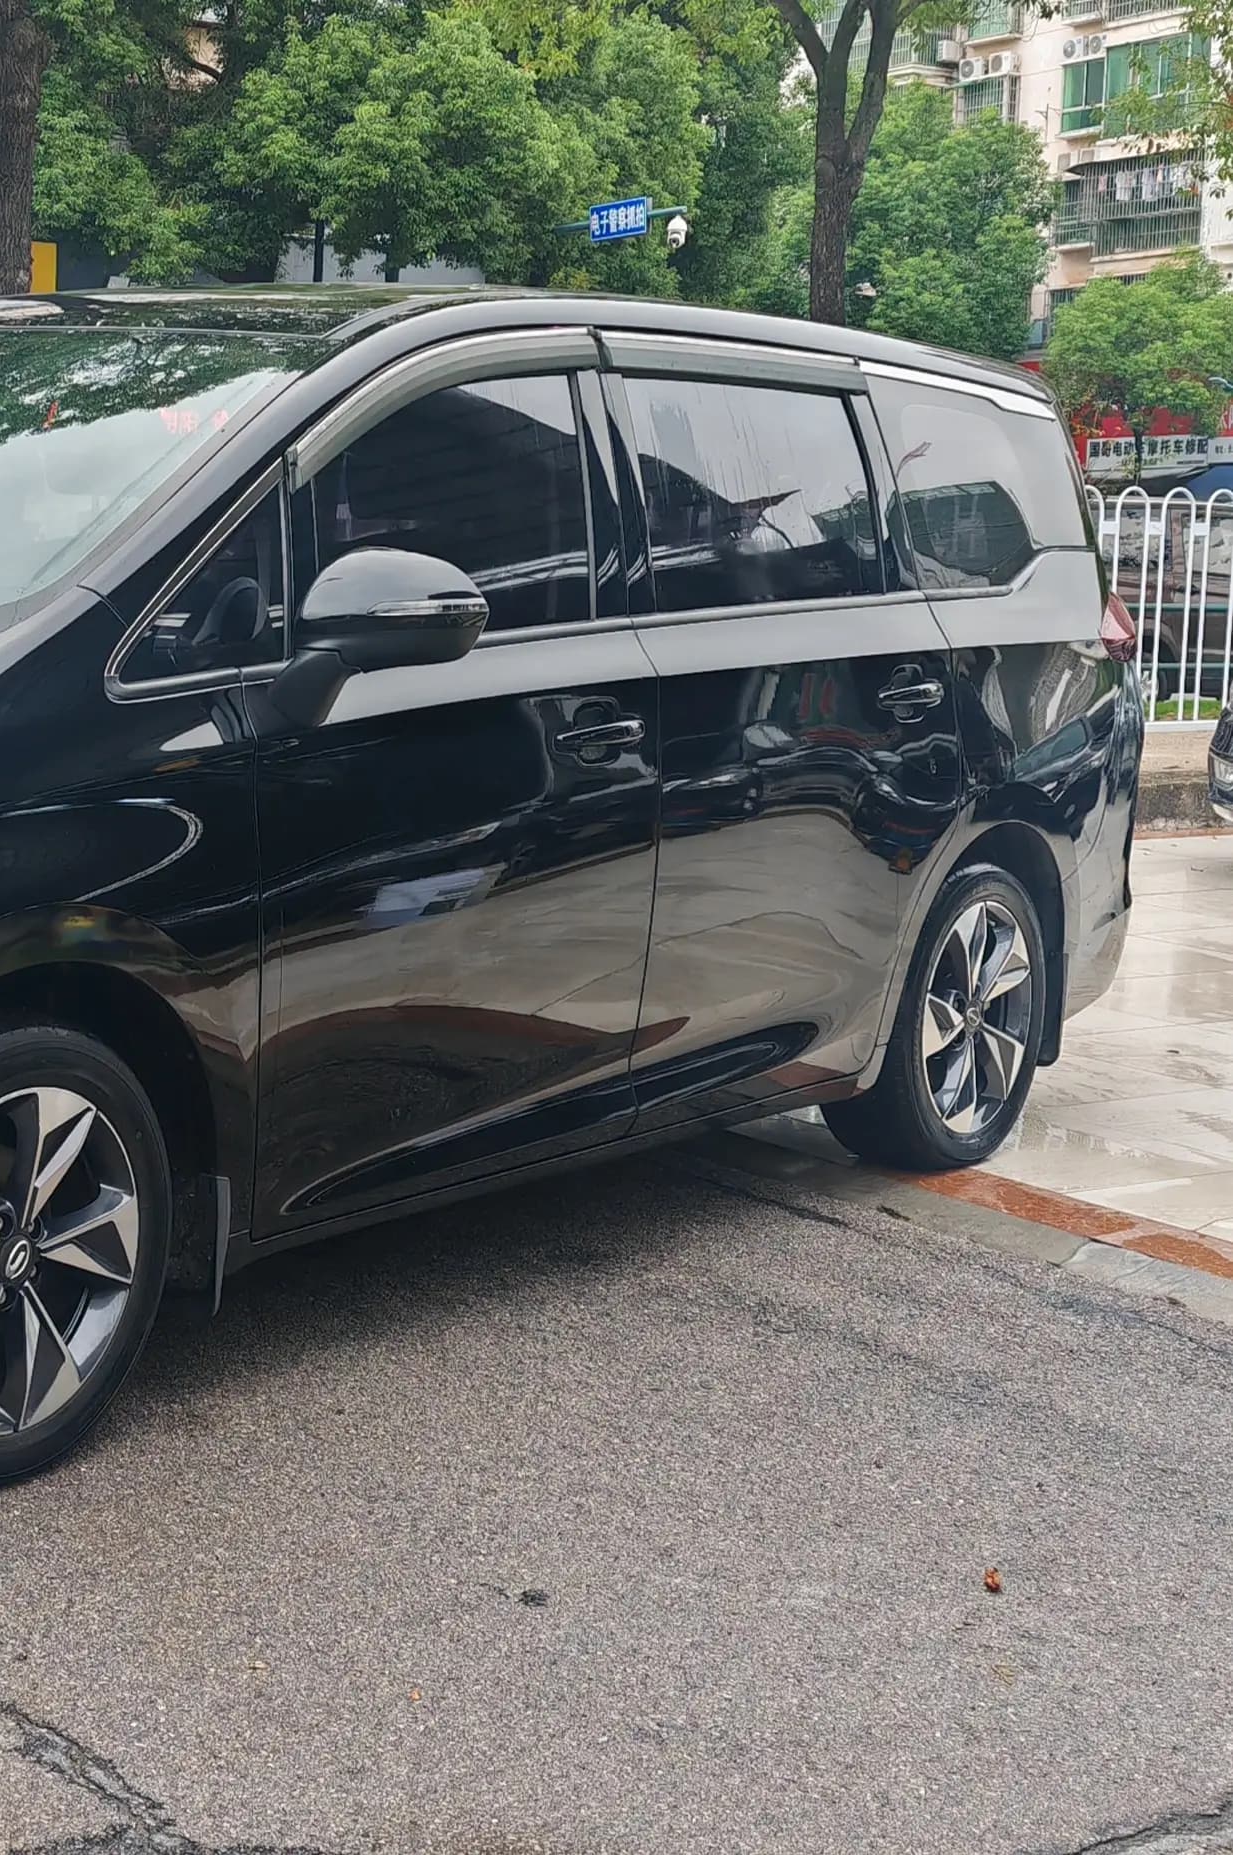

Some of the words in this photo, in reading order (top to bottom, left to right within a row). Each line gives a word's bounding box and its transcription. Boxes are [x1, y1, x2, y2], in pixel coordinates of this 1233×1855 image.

[591, 203, 645, 235] 电子警察抓拍
